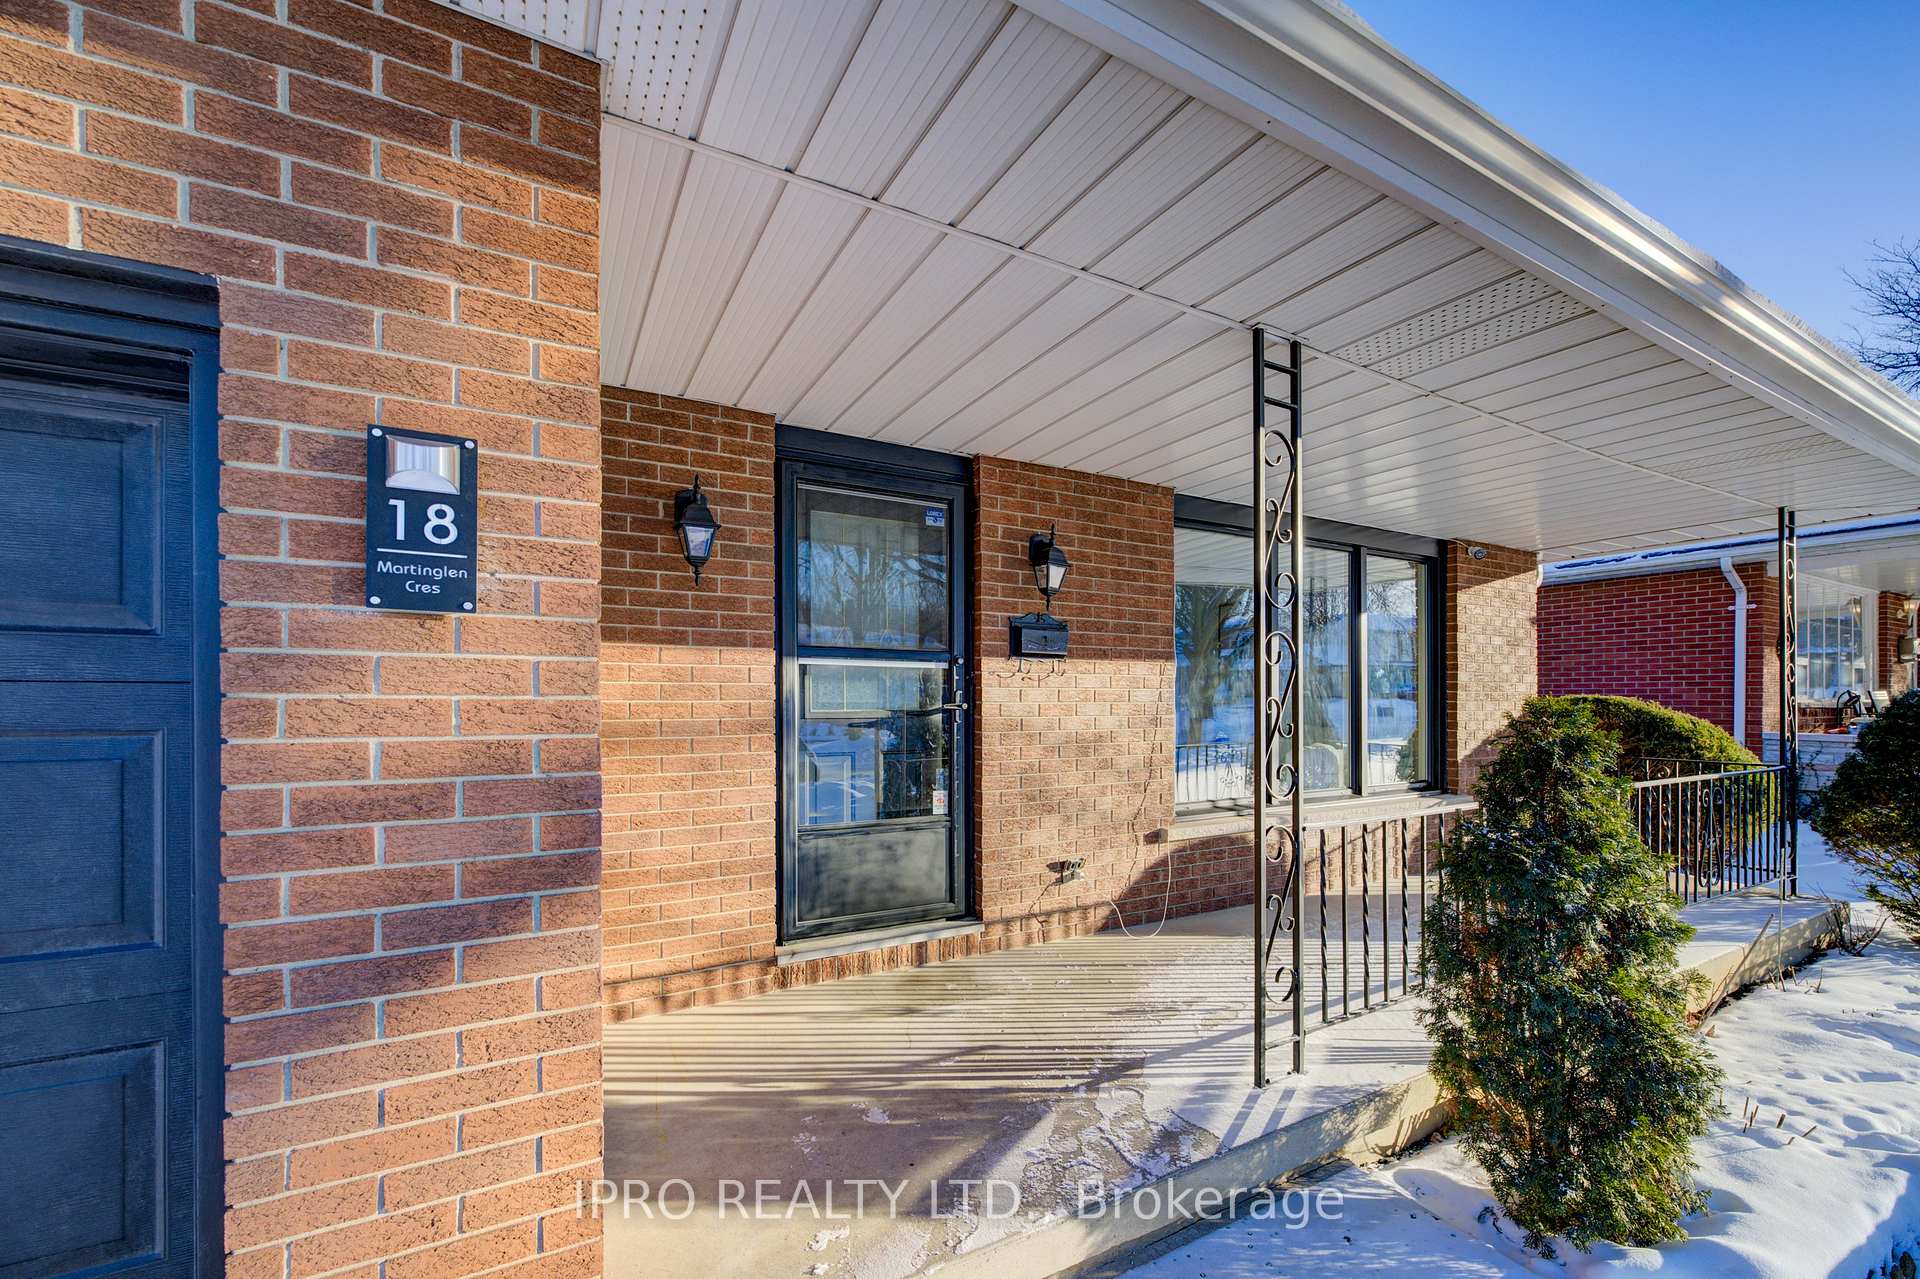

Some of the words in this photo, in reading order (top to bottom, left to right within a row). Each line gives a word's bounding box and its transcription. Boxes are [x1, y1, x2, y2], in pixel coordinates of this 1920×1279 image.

[388, 499, 458, 545] 18
[376, 560, 468, 580] Martinglen
[405, 580, 441, 594] Cres
